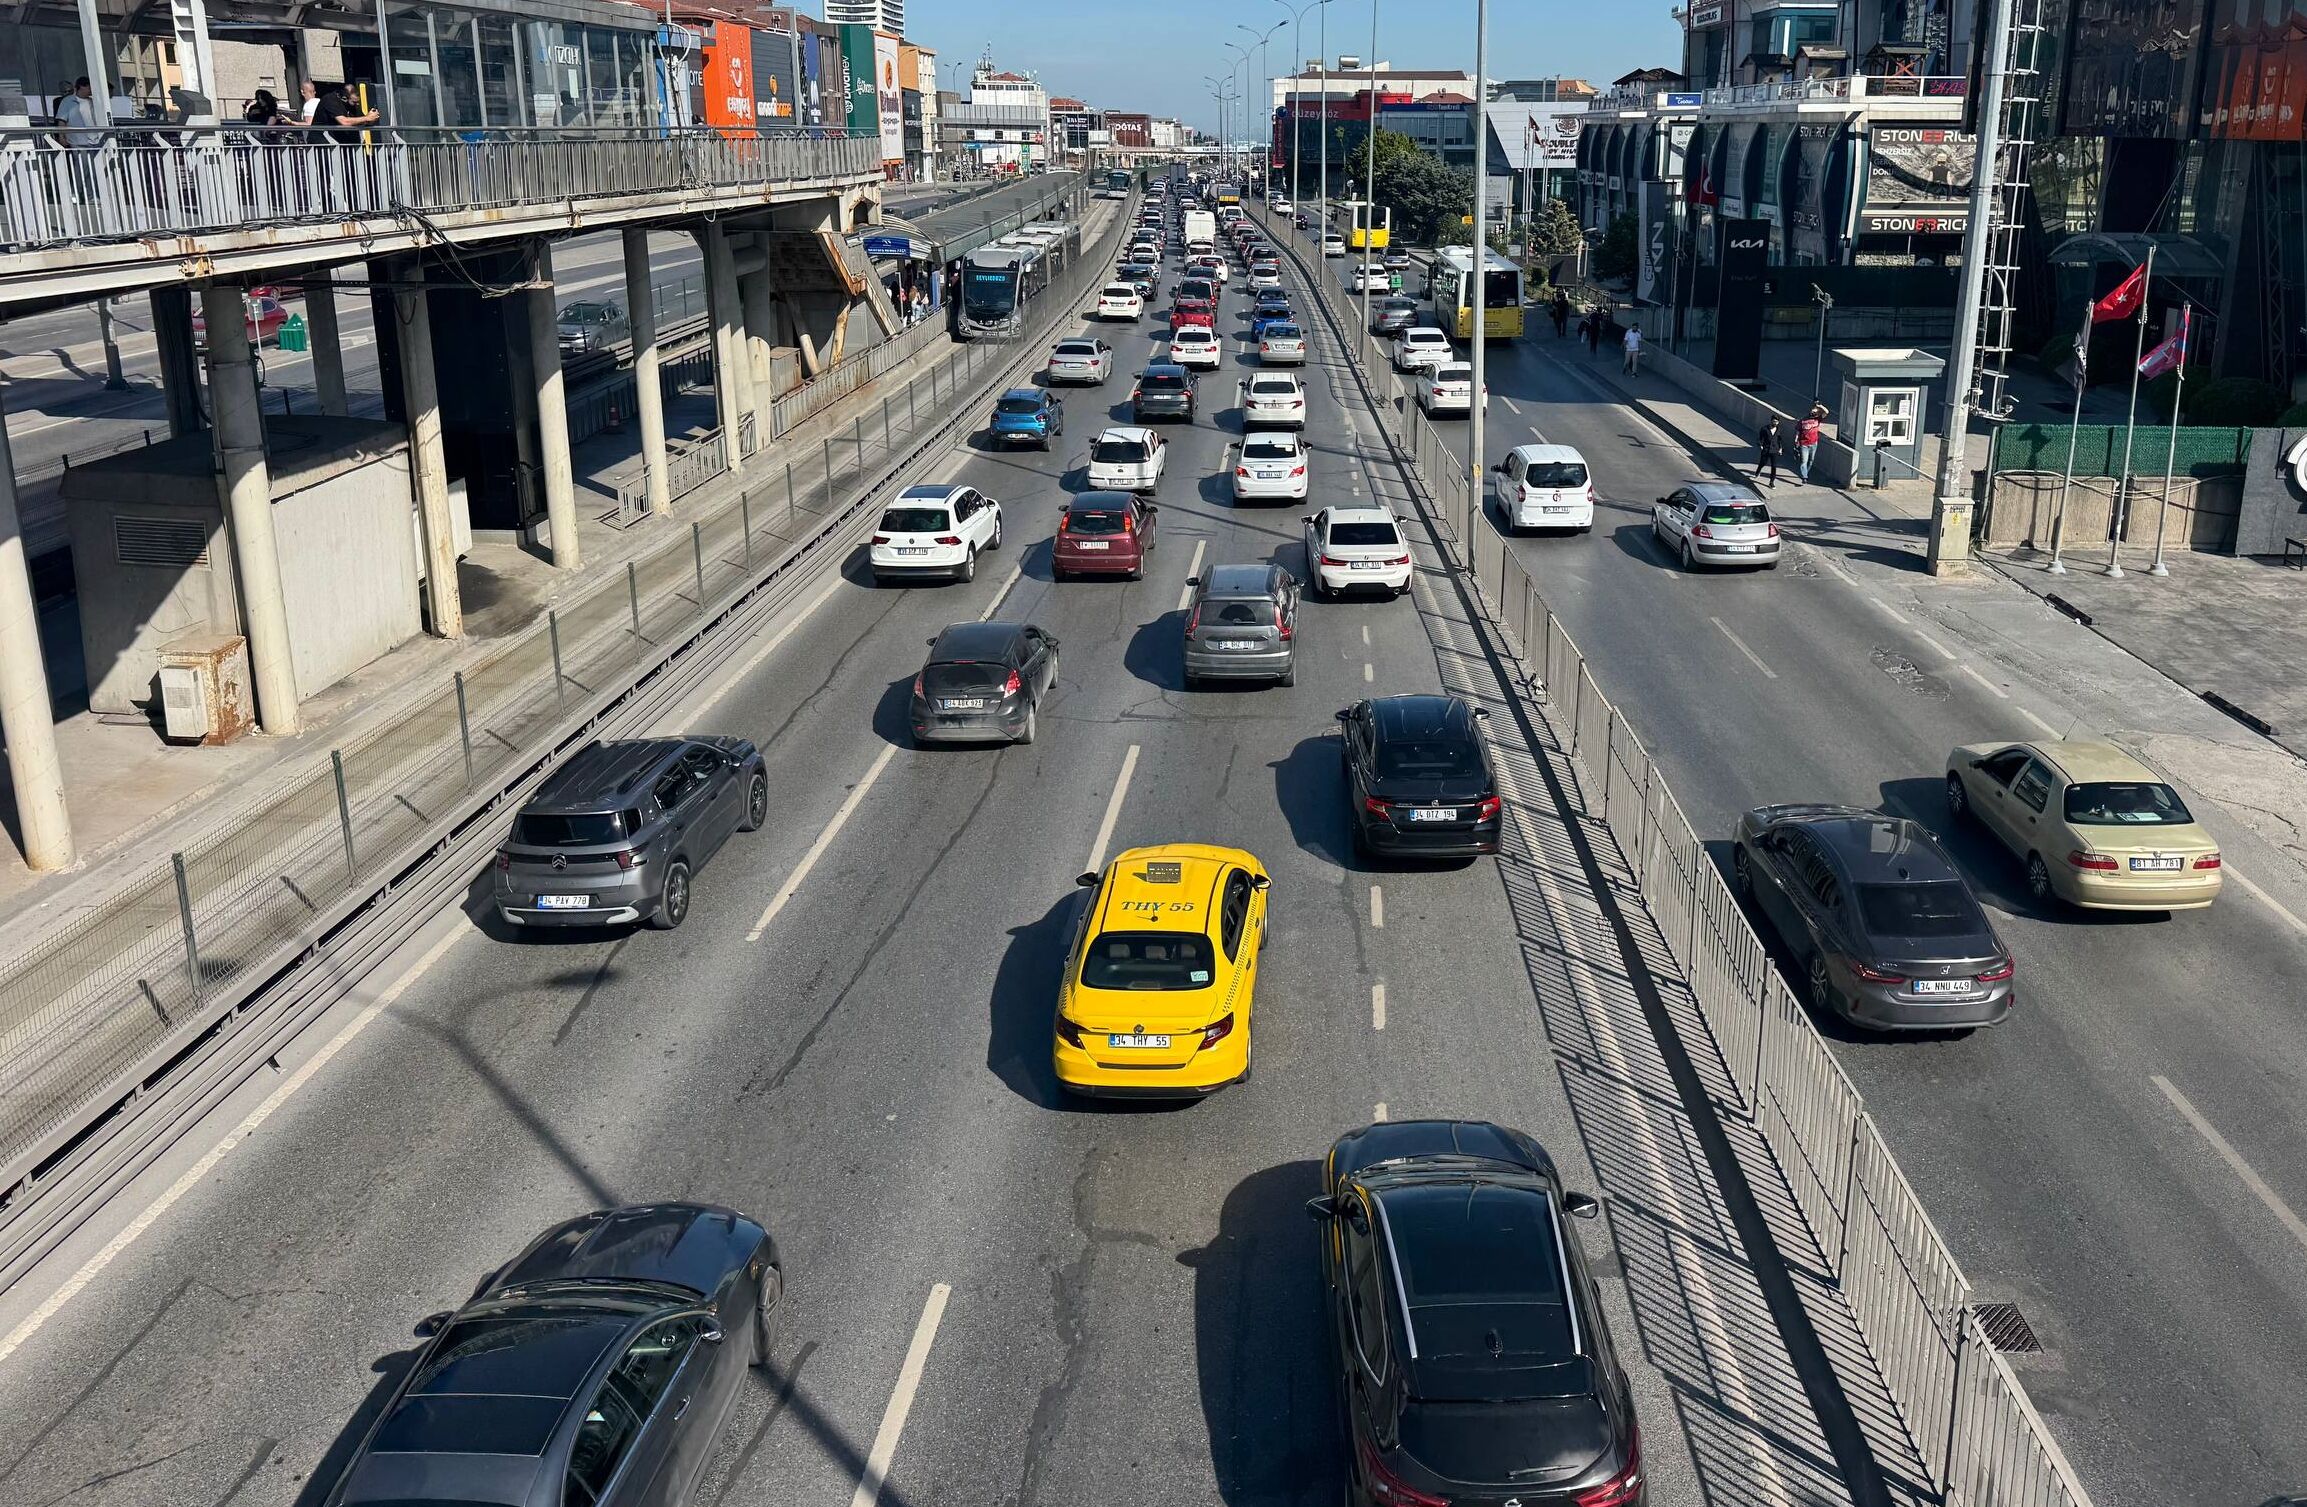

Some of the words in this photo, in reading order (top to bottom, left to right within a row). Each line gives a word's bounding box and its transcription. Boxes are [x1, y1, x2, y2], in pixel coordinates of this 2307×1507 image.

[1730, 239, 1764, 248] KIA
[1416, 810, 1424, 818] 34
[1444, 810, 1455, 818] 194
[2136, 860, 2147, 868] 81
[543, 896, 552, 905] 34
[1122, 901, 1165, 912] THY
[1170, 902, 1195, 912] 55
[1920, 983, 1930, 992] 34
[1934, 982, 1951, 991] NNU
[1953, 982, 1970, 991] 449
[1115, 1035, 1126, 1046] 34
[1132, 1035, 1148, 1047] THY
[1156, 1036, 1167, 1046] 55
